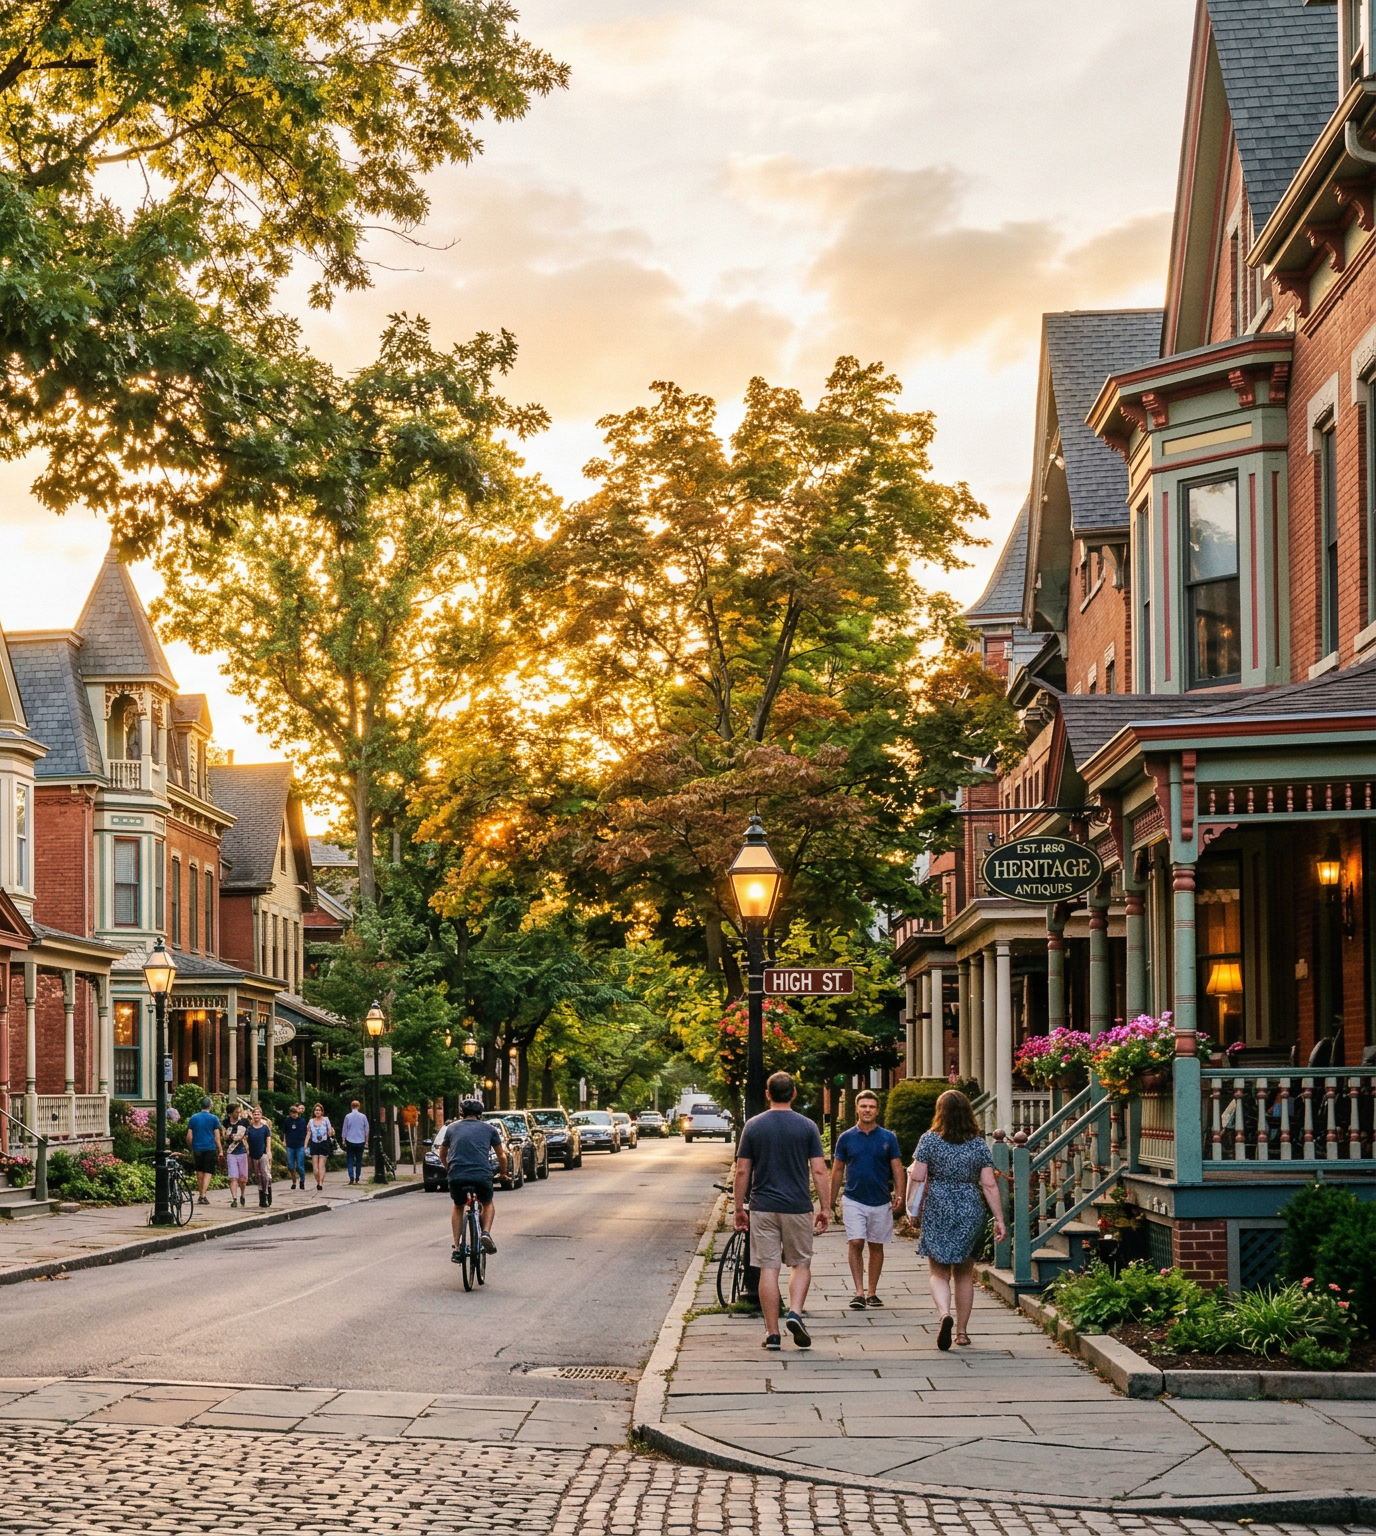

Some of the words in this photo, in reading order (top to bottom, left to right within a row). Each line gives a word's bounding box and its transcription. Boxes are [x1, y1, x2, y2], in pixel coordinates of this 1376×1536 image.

[1017, 844, 1039, 854] EST.
[993, 858, 1092, 879] HERITAGE
[773, 972, 812, 991] HIGH
[822, 972, 844, 991] ST.
